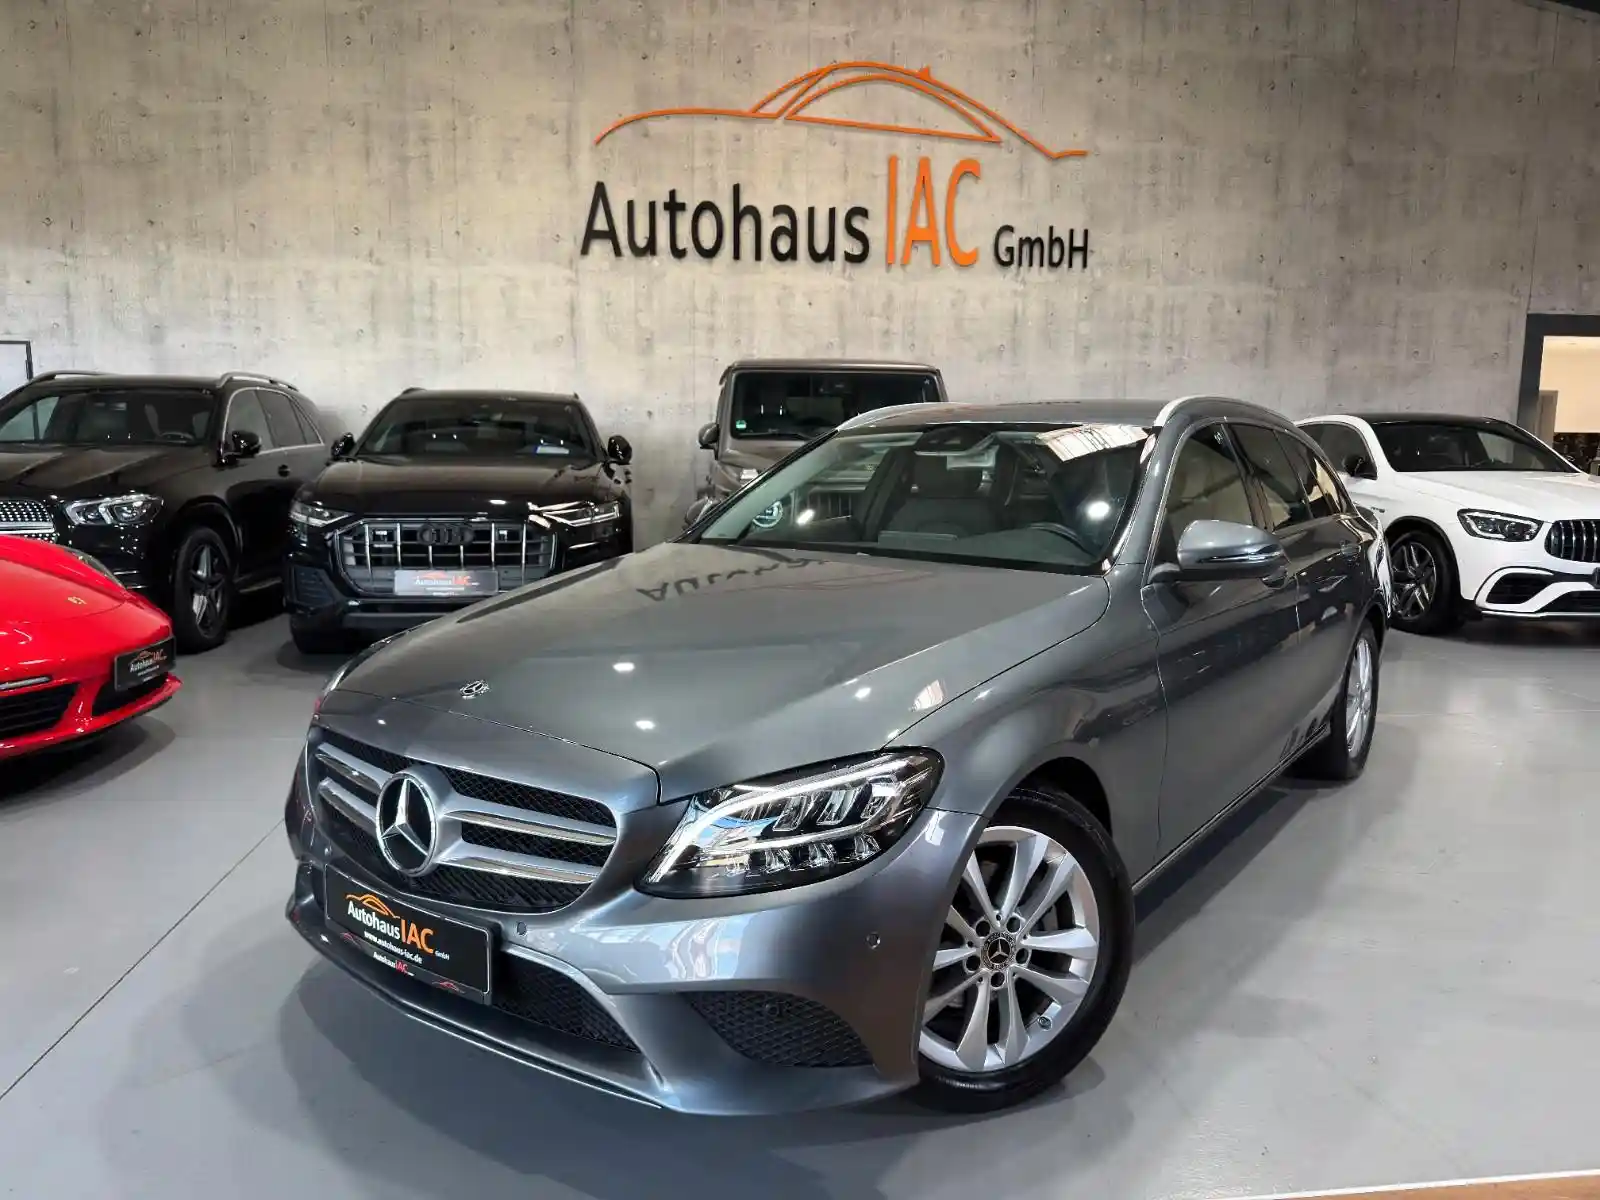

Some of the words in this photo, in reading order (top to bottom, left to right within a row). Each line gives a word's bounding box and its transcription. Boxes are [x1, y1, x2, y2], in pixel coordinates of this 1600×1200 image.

[579, 180, 871, 264] Autohaus
[884, 153, 981, 267] IAC
[993, 224, 1089, 269] GmbH
[347, 900, 401, 940] Autohaus
[400, 918, 435, 954] IAC
[363, 930, 423, 965] www.autohaus-iac.de
